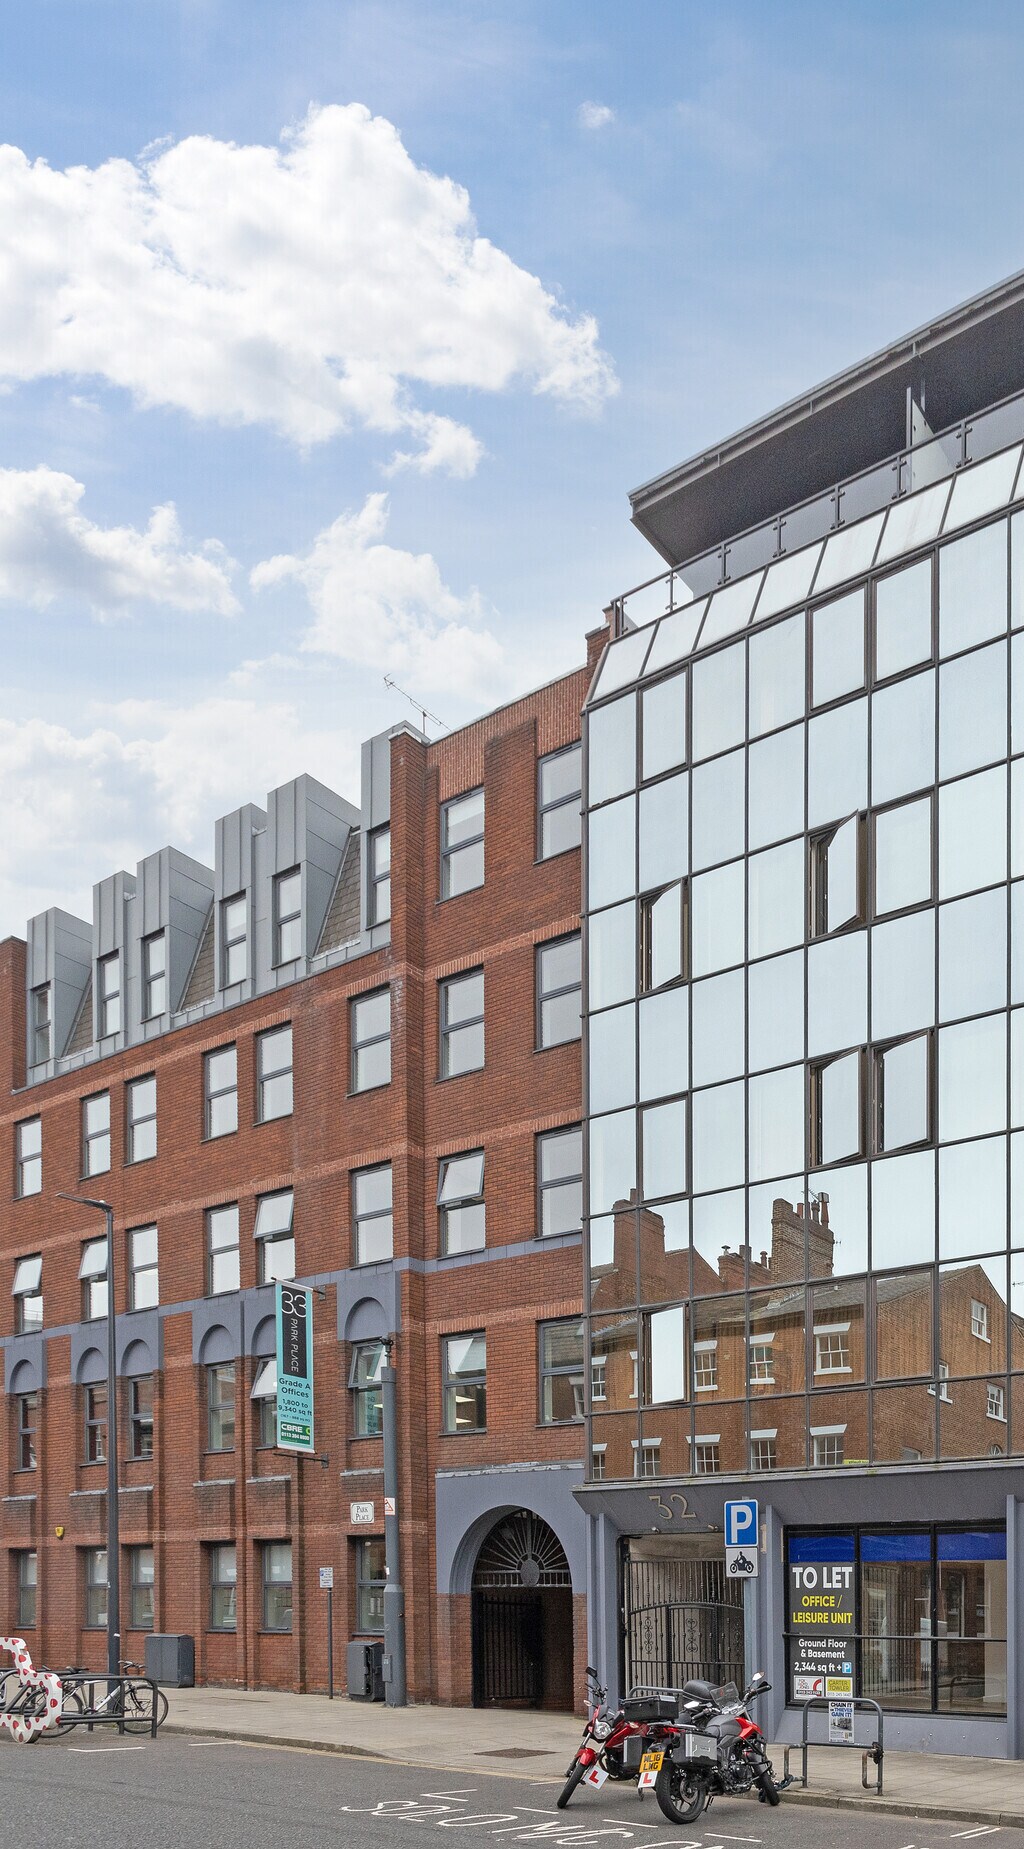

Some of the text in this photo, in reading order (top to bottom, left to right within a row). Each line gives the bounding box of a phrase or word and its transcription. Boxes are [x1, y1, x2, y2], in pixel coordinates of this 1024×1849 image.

[281, 1290, 307, 1318] 33
[290, 1317, 299, 1373] PARK PLACE
[279, 1377, 303, 1389] Grade
[281, 1387, 309, 1398] Offices
[282, 1398, 300, 1407] 1,800
[278, 1405, 297, 1413] 9,340
[281, 1423, 303, 1433] CBRE
[356, 1505, 368, 1513] PARK
[648, 1493, 697, 1520] 32
[355, 1513, 370, 1521] PLACE
[730, 1504, 753, 1544] P
[792, 1566, 853, 1589] TO LET
[801, 1595, 836, 1607] OFFICE
[792, 1611, 853, 1624] LEISURE UNIT
[798, 1638, 847, 1648] Ground Floor
[800, 1648, 845, 1659] & Basement
[794, 1661, 816, 1672] 2,344
[817, 1664, 827, 1674] sq
[828, 1662, 836, 1672] ft
[588, 1769, 599, 1784] L
[642, 1773, 652, 1784] L
[340, 1800, 518, 1826] SOLO
